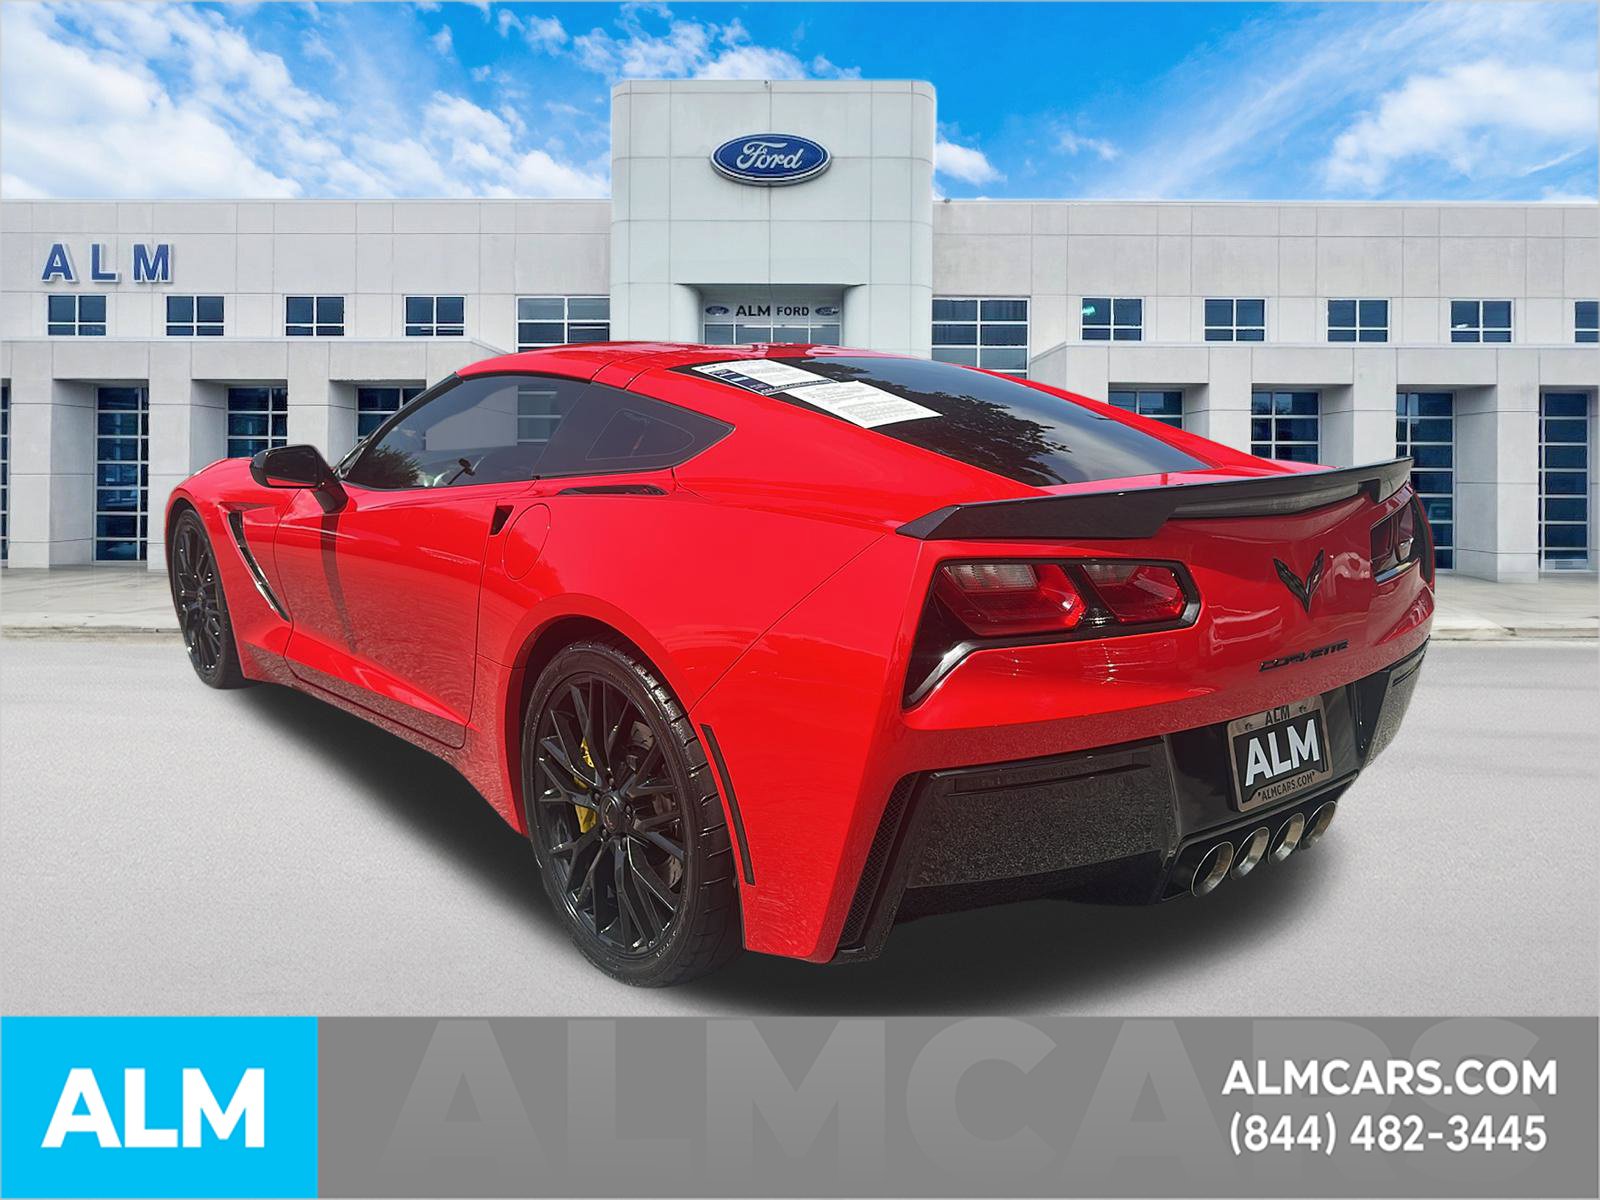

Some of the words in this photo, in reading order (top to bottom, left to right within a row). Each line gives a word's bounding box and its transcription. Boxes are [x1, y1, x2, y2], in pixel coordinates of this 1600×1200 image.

[736, 141, 804, 170] Ford
[41, 242, 174, 285] ALM
[735, 305, 771, 317] ALM
[776, 306, 810, 316] FORD
[1245, 718, 1321, 787] ALM
